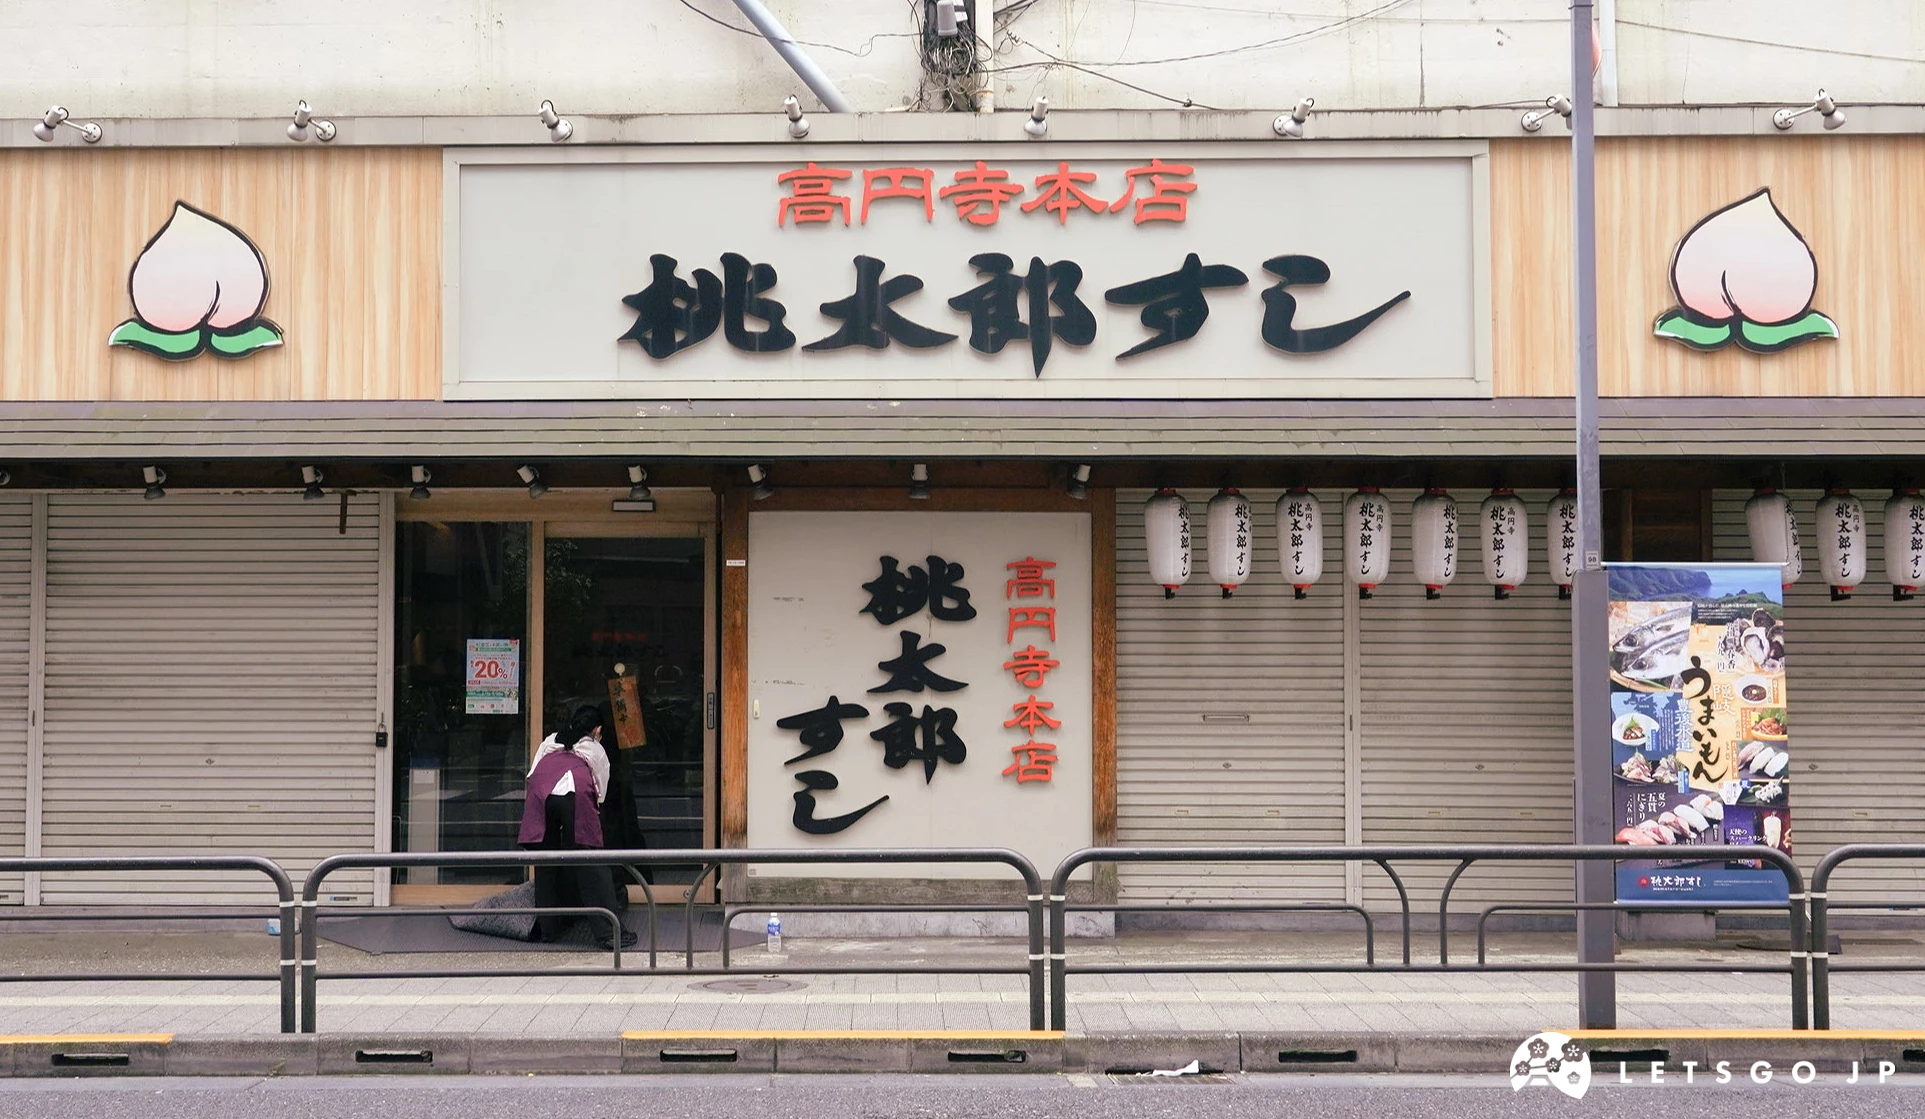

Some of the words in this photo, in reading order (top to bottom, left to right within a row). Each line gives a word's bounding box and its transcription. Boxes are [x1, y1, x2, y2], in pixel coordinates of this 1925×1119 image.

[776, 158, 1199, 228] 高円寺本店
[617, 251, 1412, 379] 桃太郎すし
[1179, 503, 1190, 577] 桃太郎すし
[1235, 503, 1249, 576] 桃太郎すし
[1288, 501, 1304, 575] 桃太郎すし
[1305, 502, 1313, 531] 高円寺
[1359, 501, 1376, 575] 桃太郎すし
[1376, 504, 1384, 532] 高円寺
[1443, 504, 1457, 578] 桃太郎すし
[1490, 505, 1506, 579] 桃太郎すし
[1507, 506, 1516, 535] 高円寺
[1559, 503, 1577, 578] 桃太郎すし
[1835, 502, 1852, 578] 桃太郎すし
[1909, 505, 1925, 579] 桃太郎すし
[474, 660, 508, 679] 20%
[858, 554, 978, 785] 桃太郎
[1002, 556, 1062, 784] 高円寺本店
[1681, 655, 1729, 783] うまいもん
[776, 695, 890, 835] すし
[1657, 792, 1666, 808] 夏の
[1637, 793, 1647, 822] にぎり
[1650, 875, 1701, 887] 桃太郎すし
